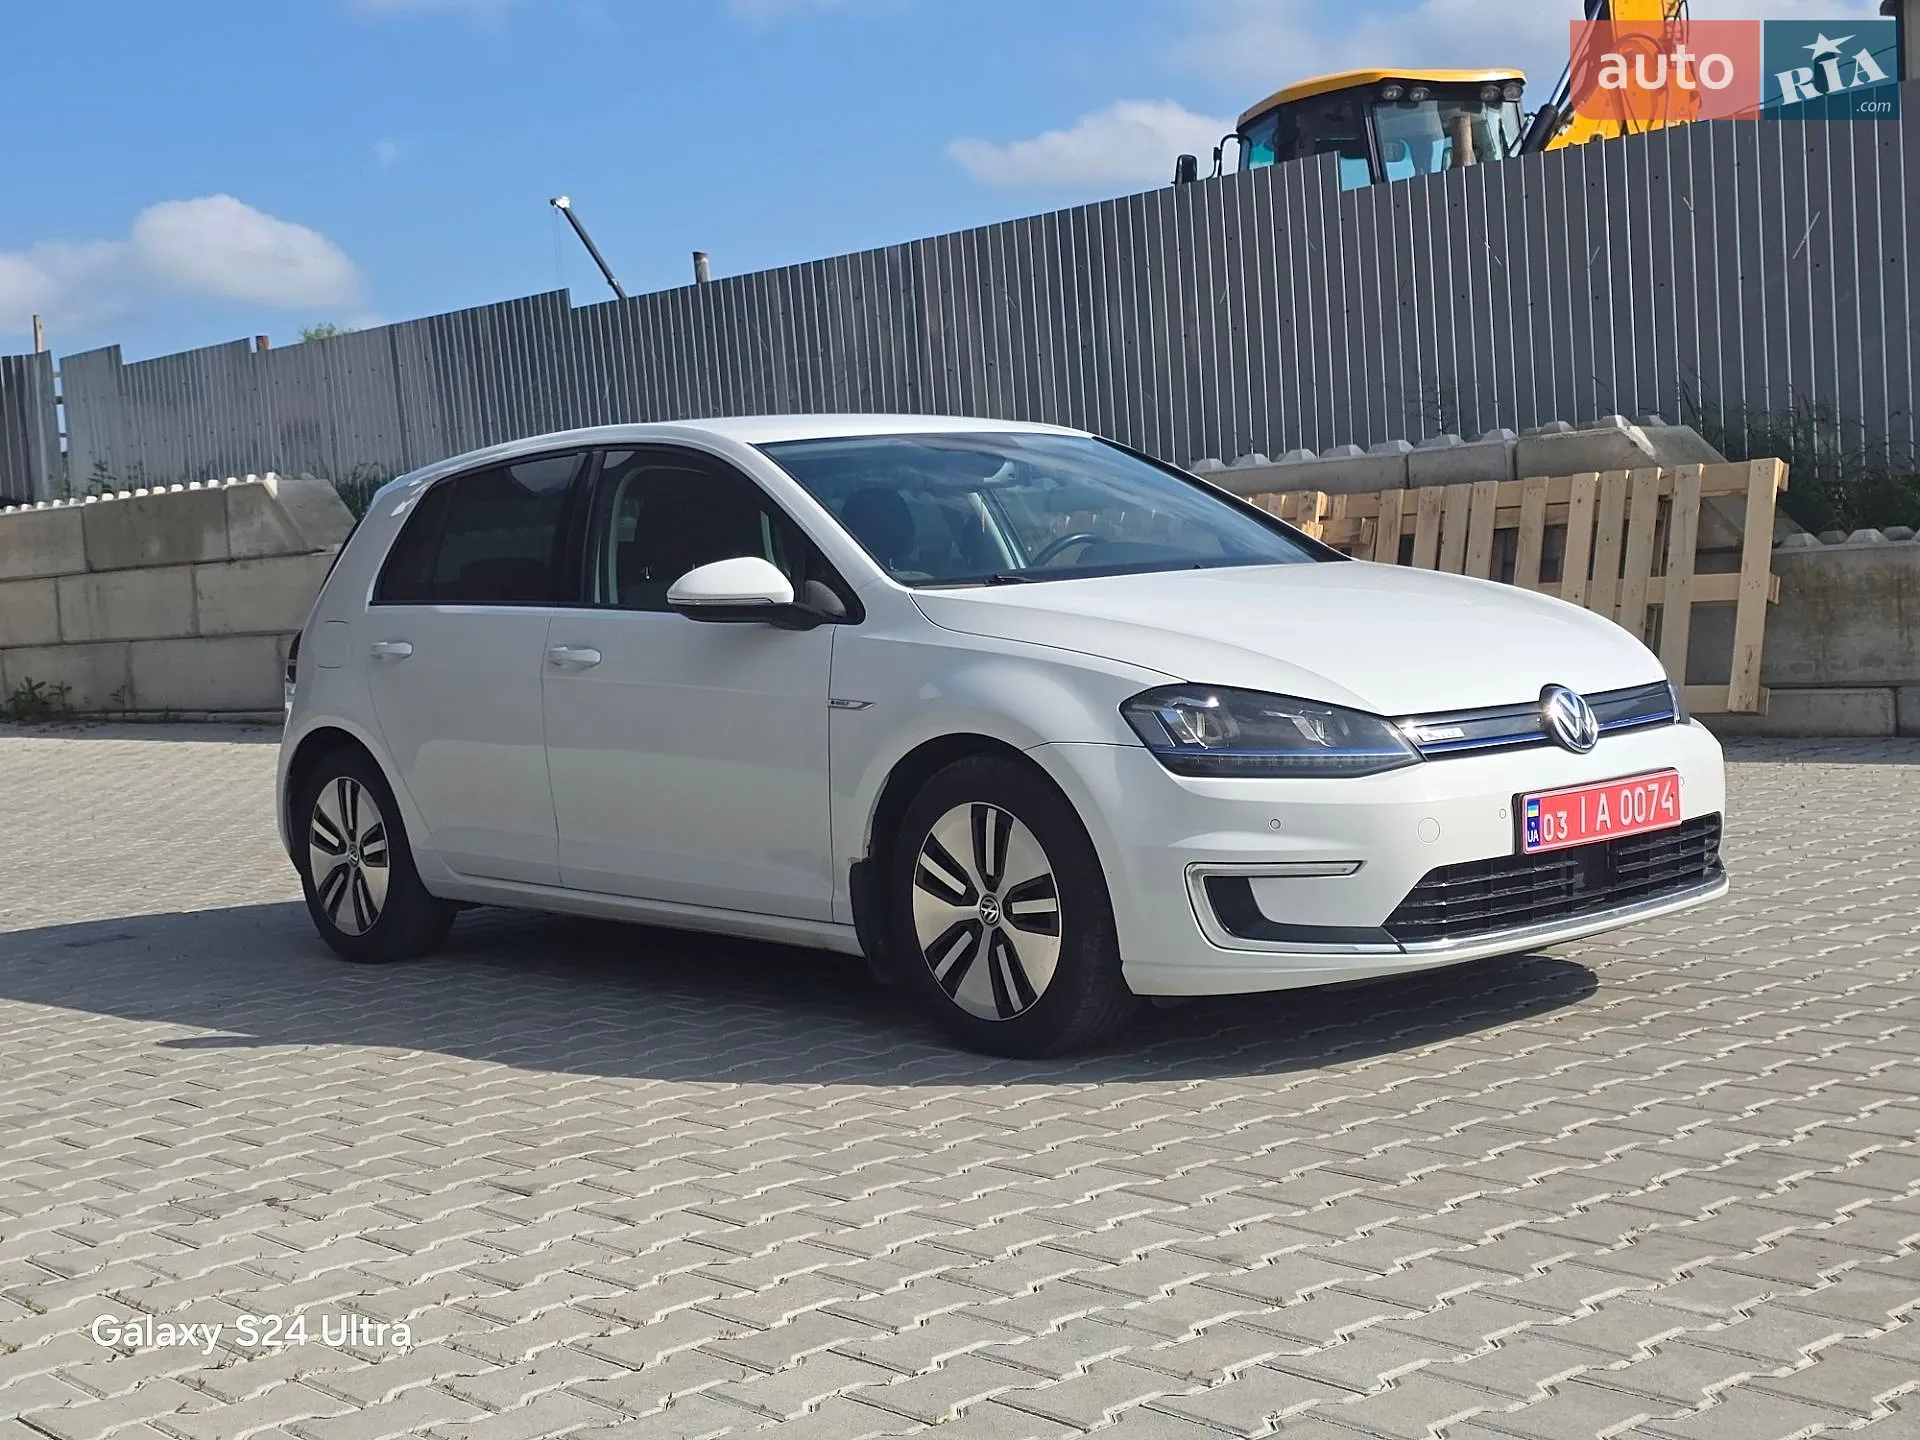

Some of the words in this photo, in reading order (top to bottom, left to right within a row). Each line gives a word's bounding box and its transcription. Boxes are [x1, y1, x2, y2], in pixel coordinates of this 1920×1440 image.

[1543, 810, 1568, 842] 03
[1620, 781, 1675, 826] 0074
[1527, 830, 1539, 843] UA
